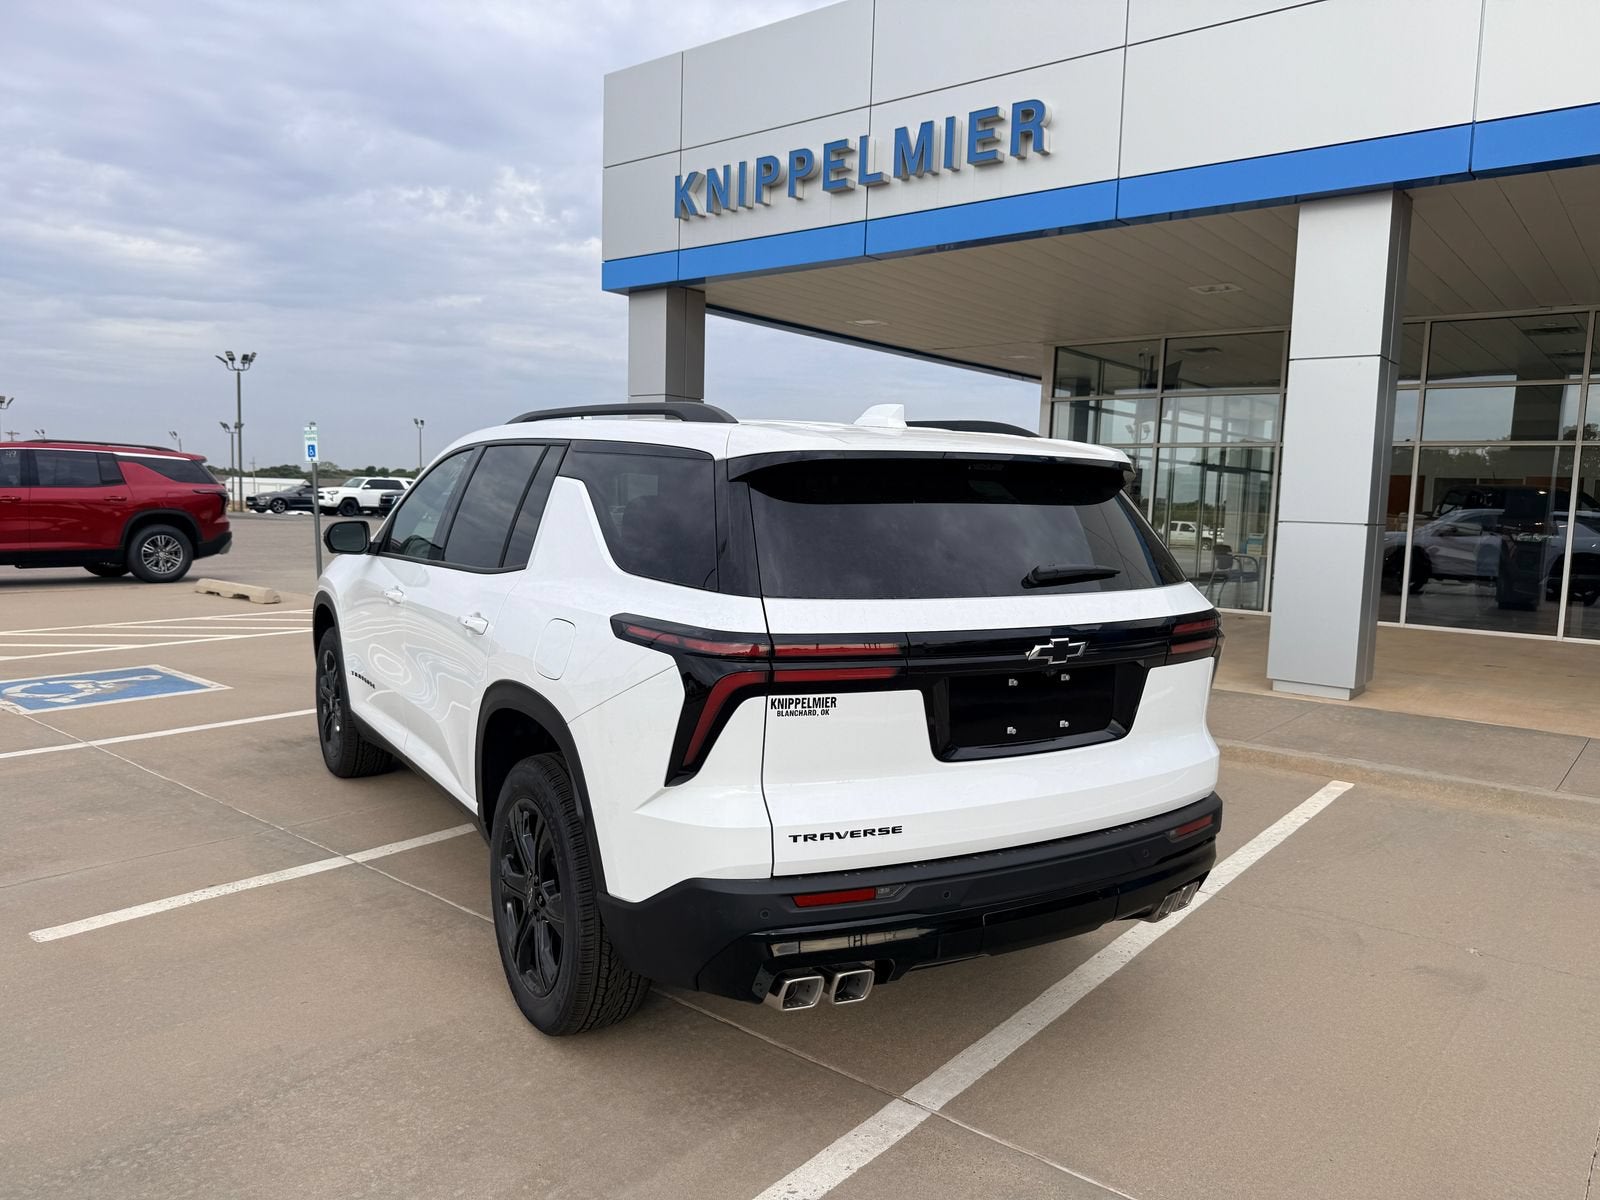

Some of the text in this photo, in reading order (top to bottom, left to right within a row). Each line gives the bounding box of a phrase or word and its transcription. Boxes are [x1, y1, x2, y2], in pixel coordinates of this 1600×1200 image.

[674, 98, 1052, 220] KNIPPELMIER
[770, 696, 837, 710] KNIPPELMIER
[788, 825, 903, 843] TRAVERSE
